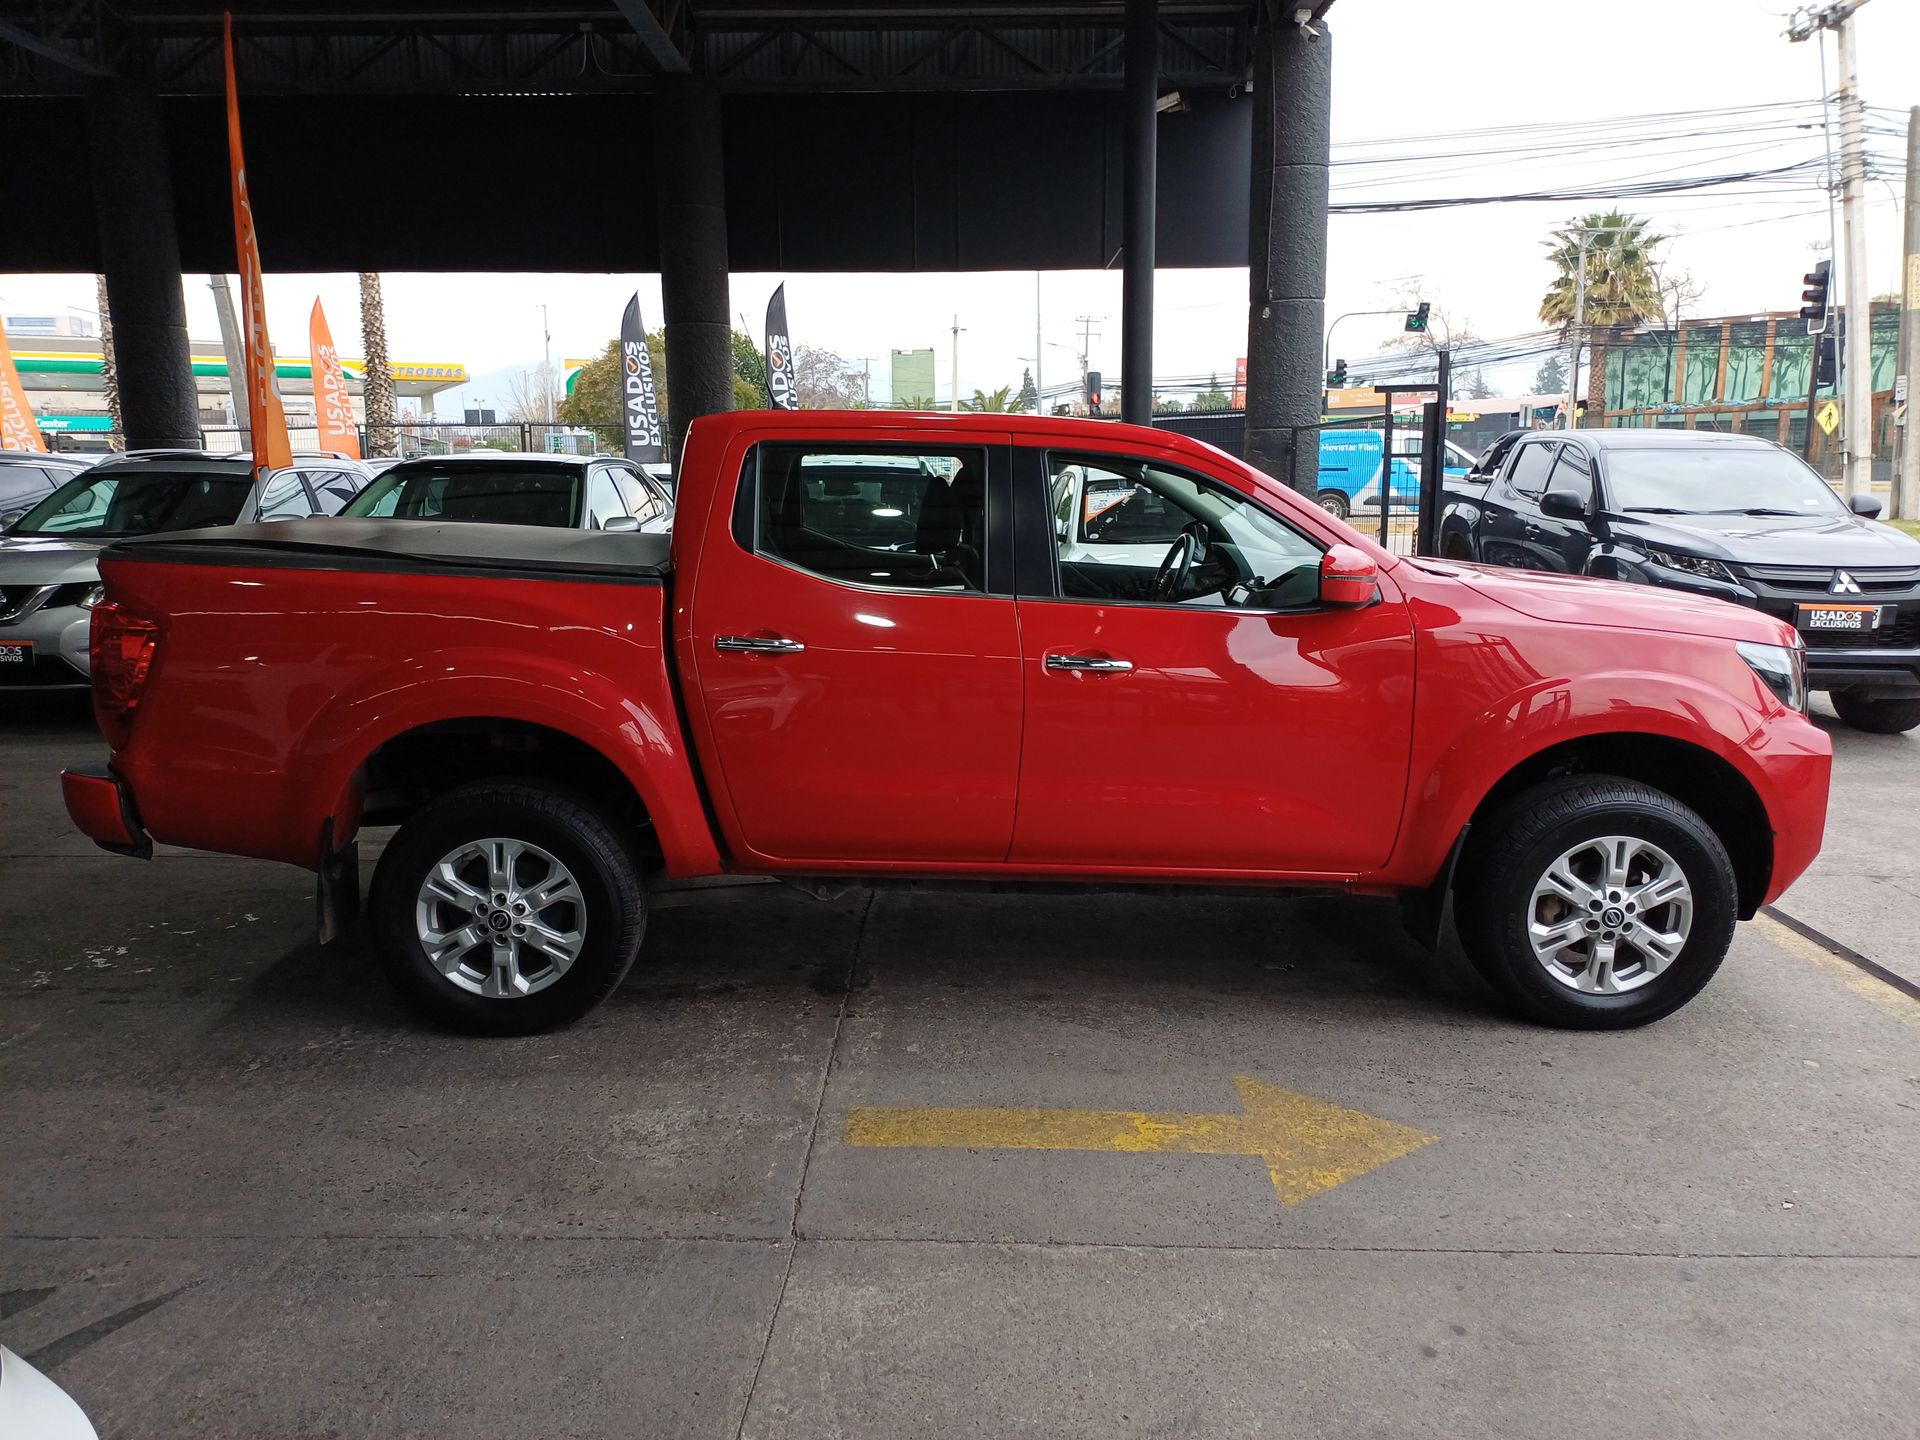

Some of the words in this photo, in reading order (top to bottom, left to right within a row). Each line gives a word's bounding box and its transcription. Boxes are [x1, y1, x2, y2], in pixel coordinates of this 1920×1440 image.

[317, 344, 345, 435] USADOS
[625, 341, 650, 446] USADOS
[636, 341, 661, 447] EXCLUSIVOS
[769, 335, 791, 410] ADOS
[1810, 620, 1862, 629] EXCLUSIVOS
[1811, 610, 1862, 621] USADOS
